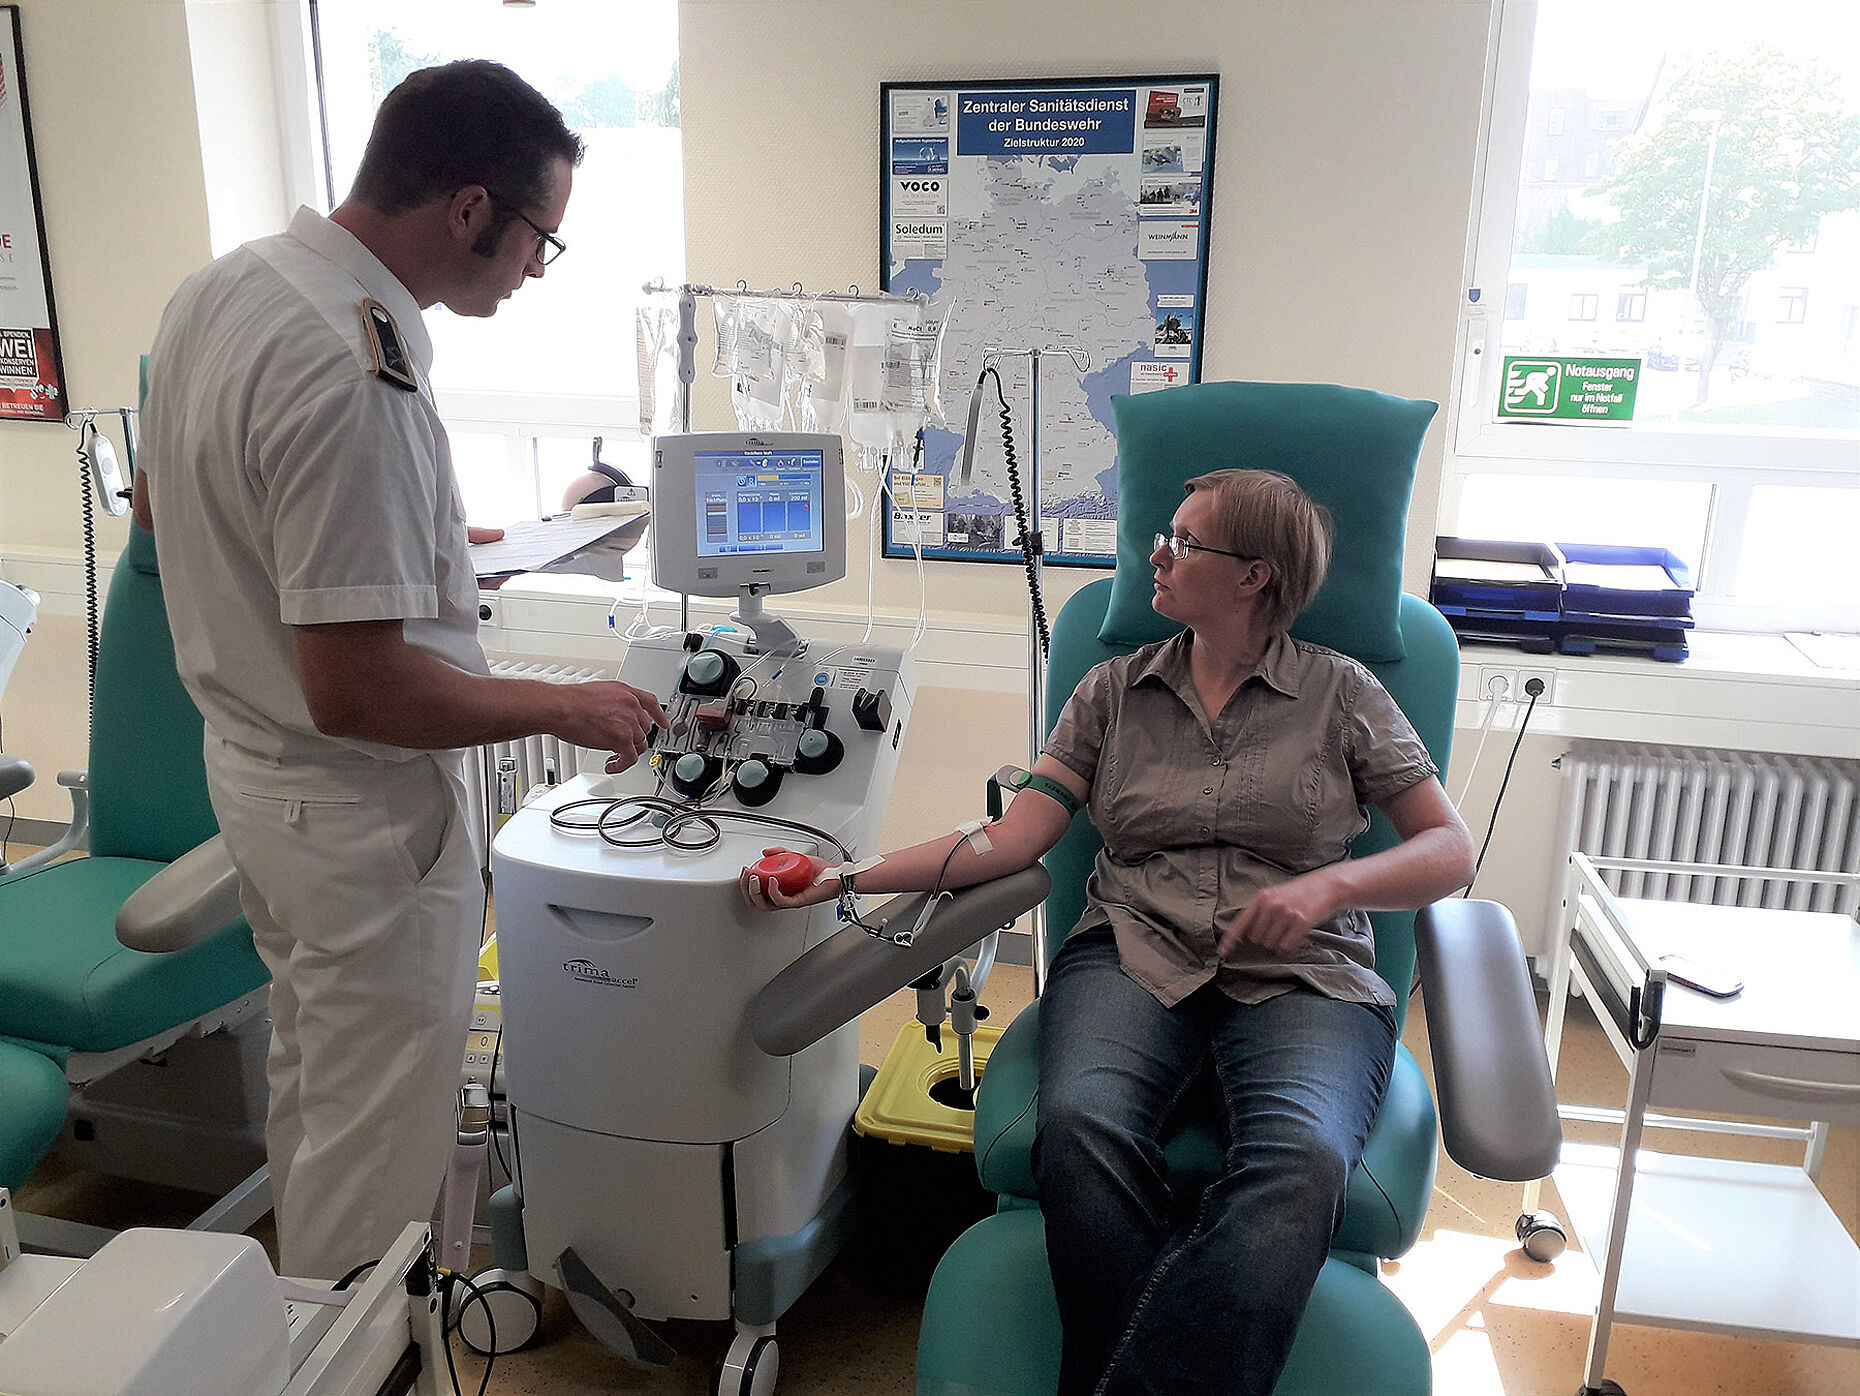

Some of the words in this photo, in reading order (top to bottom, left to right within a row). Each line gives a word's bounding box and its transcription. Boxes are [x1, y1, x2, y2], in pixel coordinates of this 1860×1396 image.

[963, 100, 1027, 114] Zentraler
[1029, 99, 1129, 112] Sanitätsdienst
[988, 118, 1012, 132] der
[1014, 118, 1102, 131] Bundeswehr
[1003, 137, 1060, 149] Zielstruktur
[1061, 137, 1085, 147] 2020
[895, 223, 943, 235] Soledum
[1565, 363, 1635, 381] Notausgang
[1582, 381, 1613, 392] Fenster
[1569, 394, 1584, 403] nur
[1584, 393, 1596, 403] im
[1596, 393, 1623, 404] Notfall
[1581, 403, 1609, 414] öffnen
[893, 512, 932, 521] Baxer
[562, 962, 610, 977] trima
